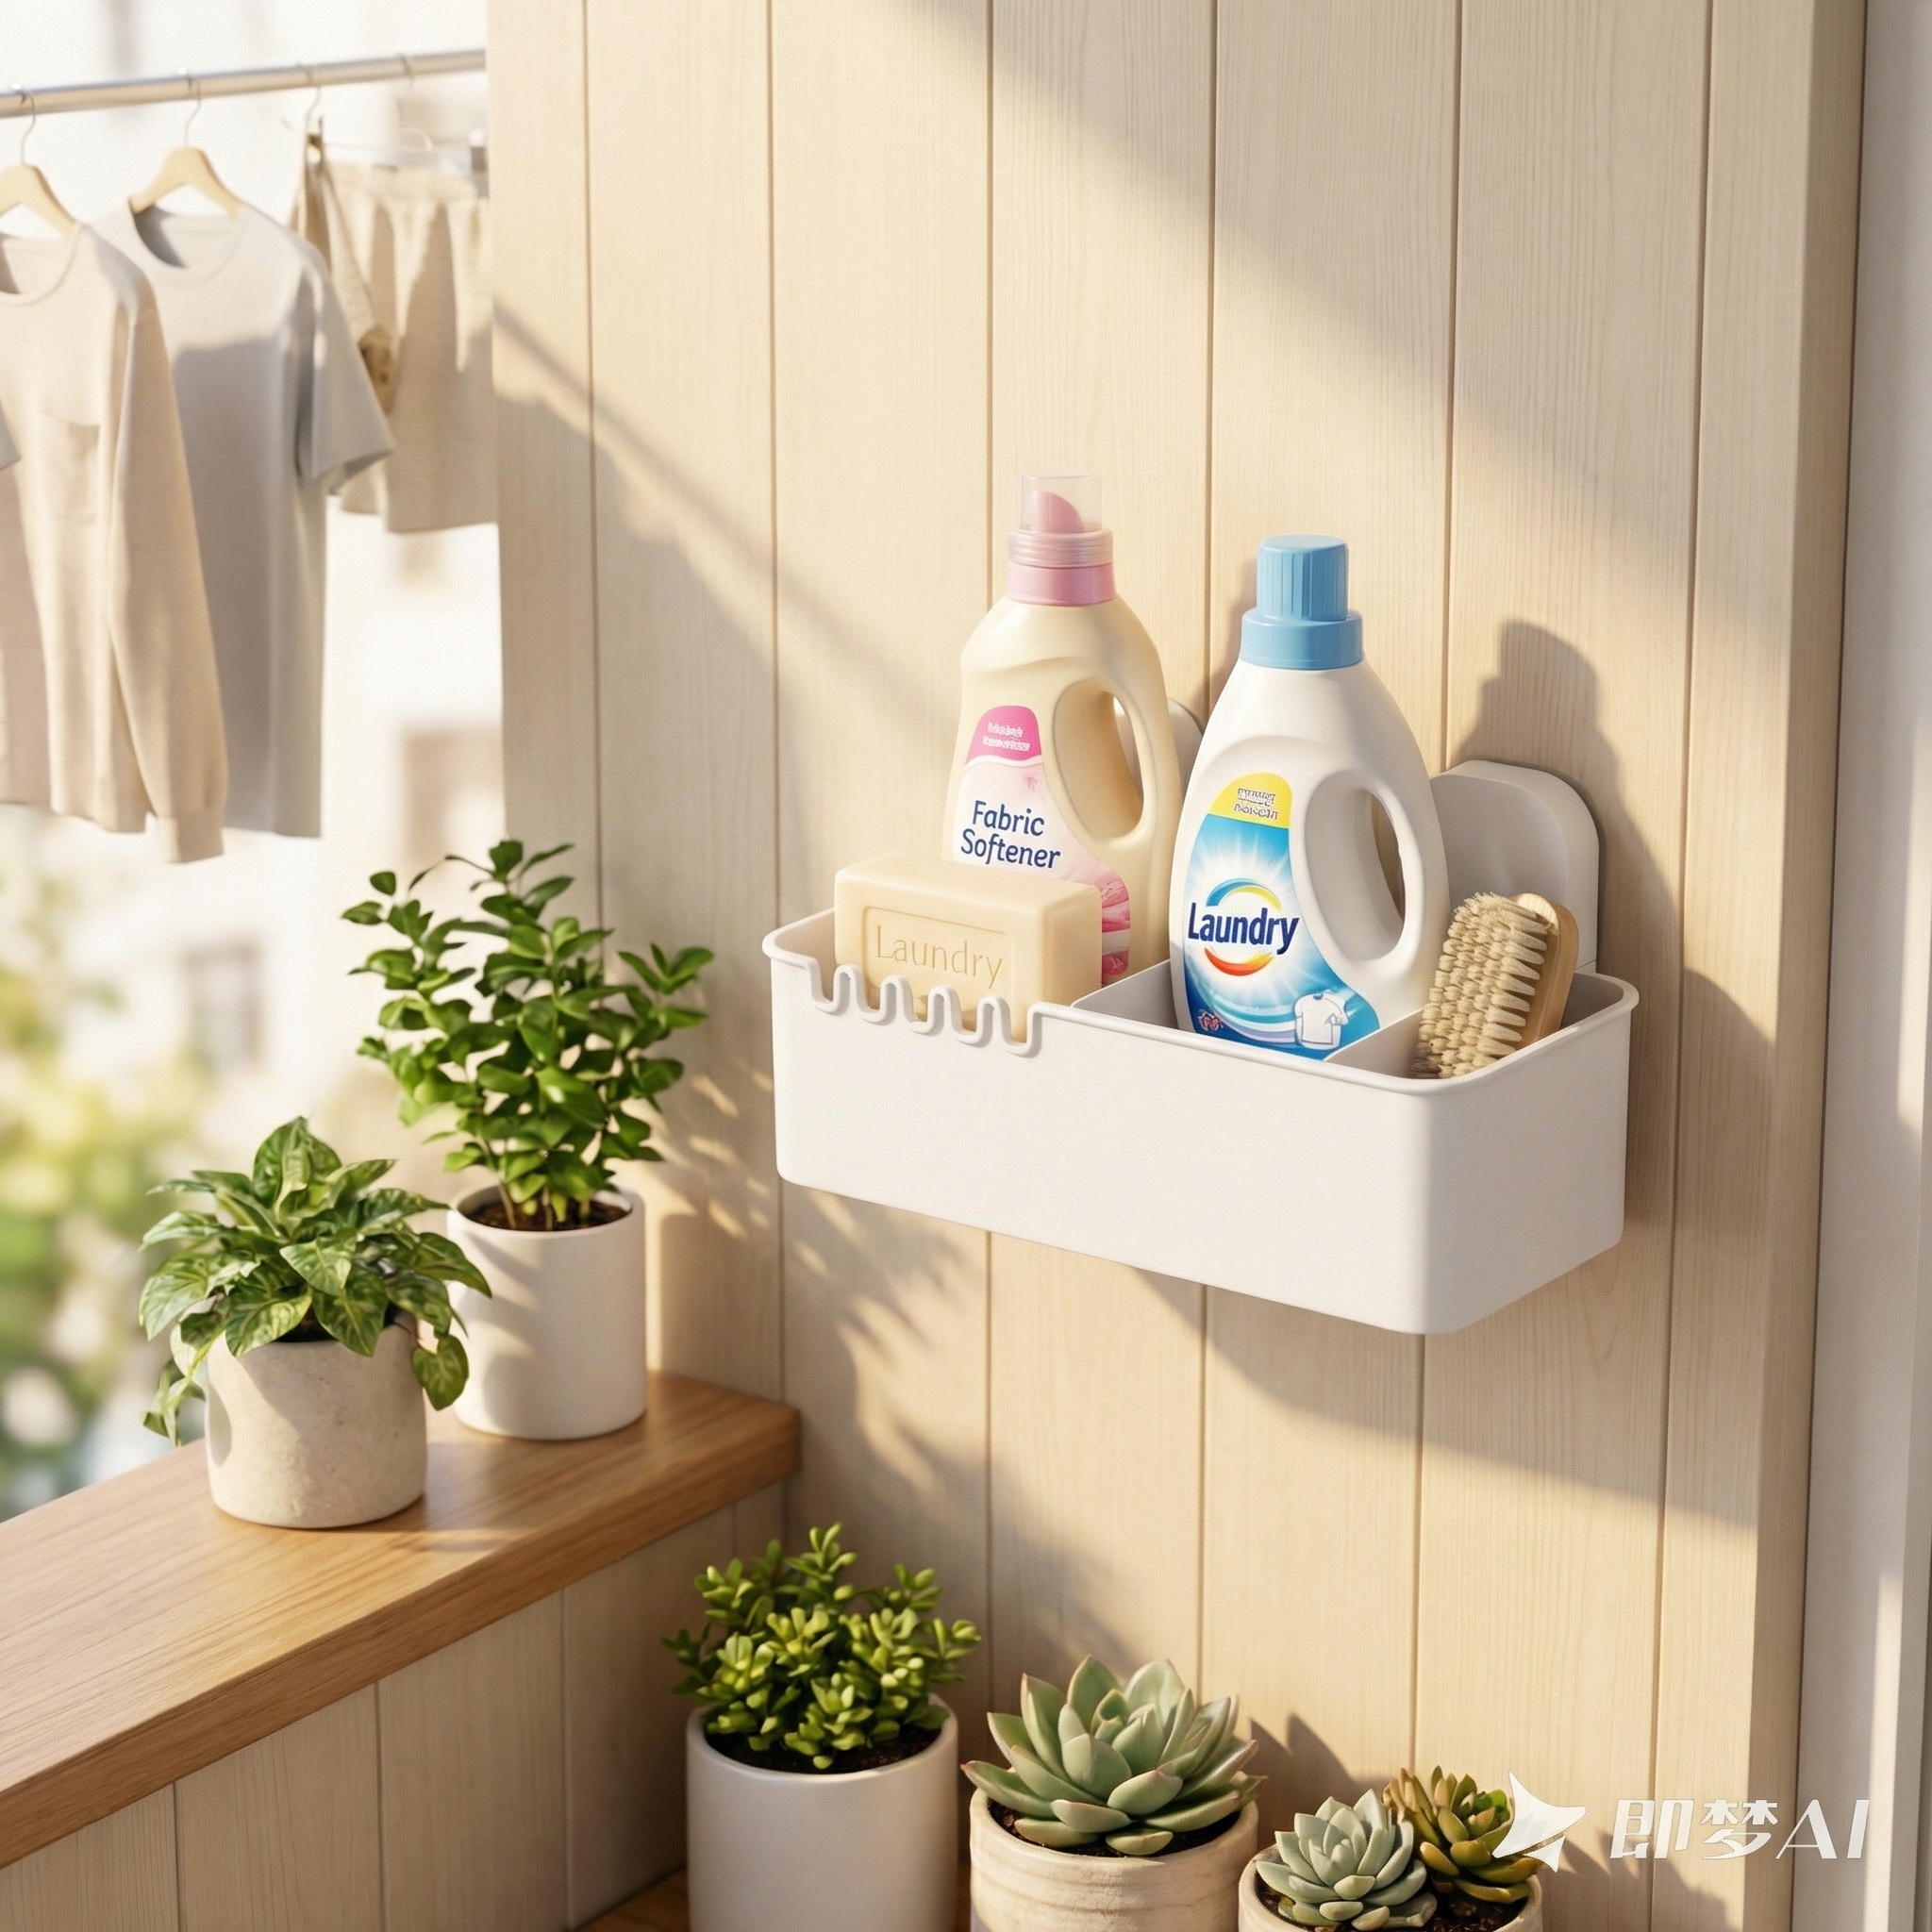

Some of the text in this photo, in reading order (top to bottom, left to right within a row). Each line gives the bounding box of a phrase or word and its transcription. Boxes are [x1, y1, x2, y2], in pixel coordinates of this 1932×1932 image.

[972, 800, 1045, 836] Fabric
[960, 828, 1060, 869] Softener
[1188, 902, 1300, 956] Laundry
[876, 924, 1003, 990] Laundry
